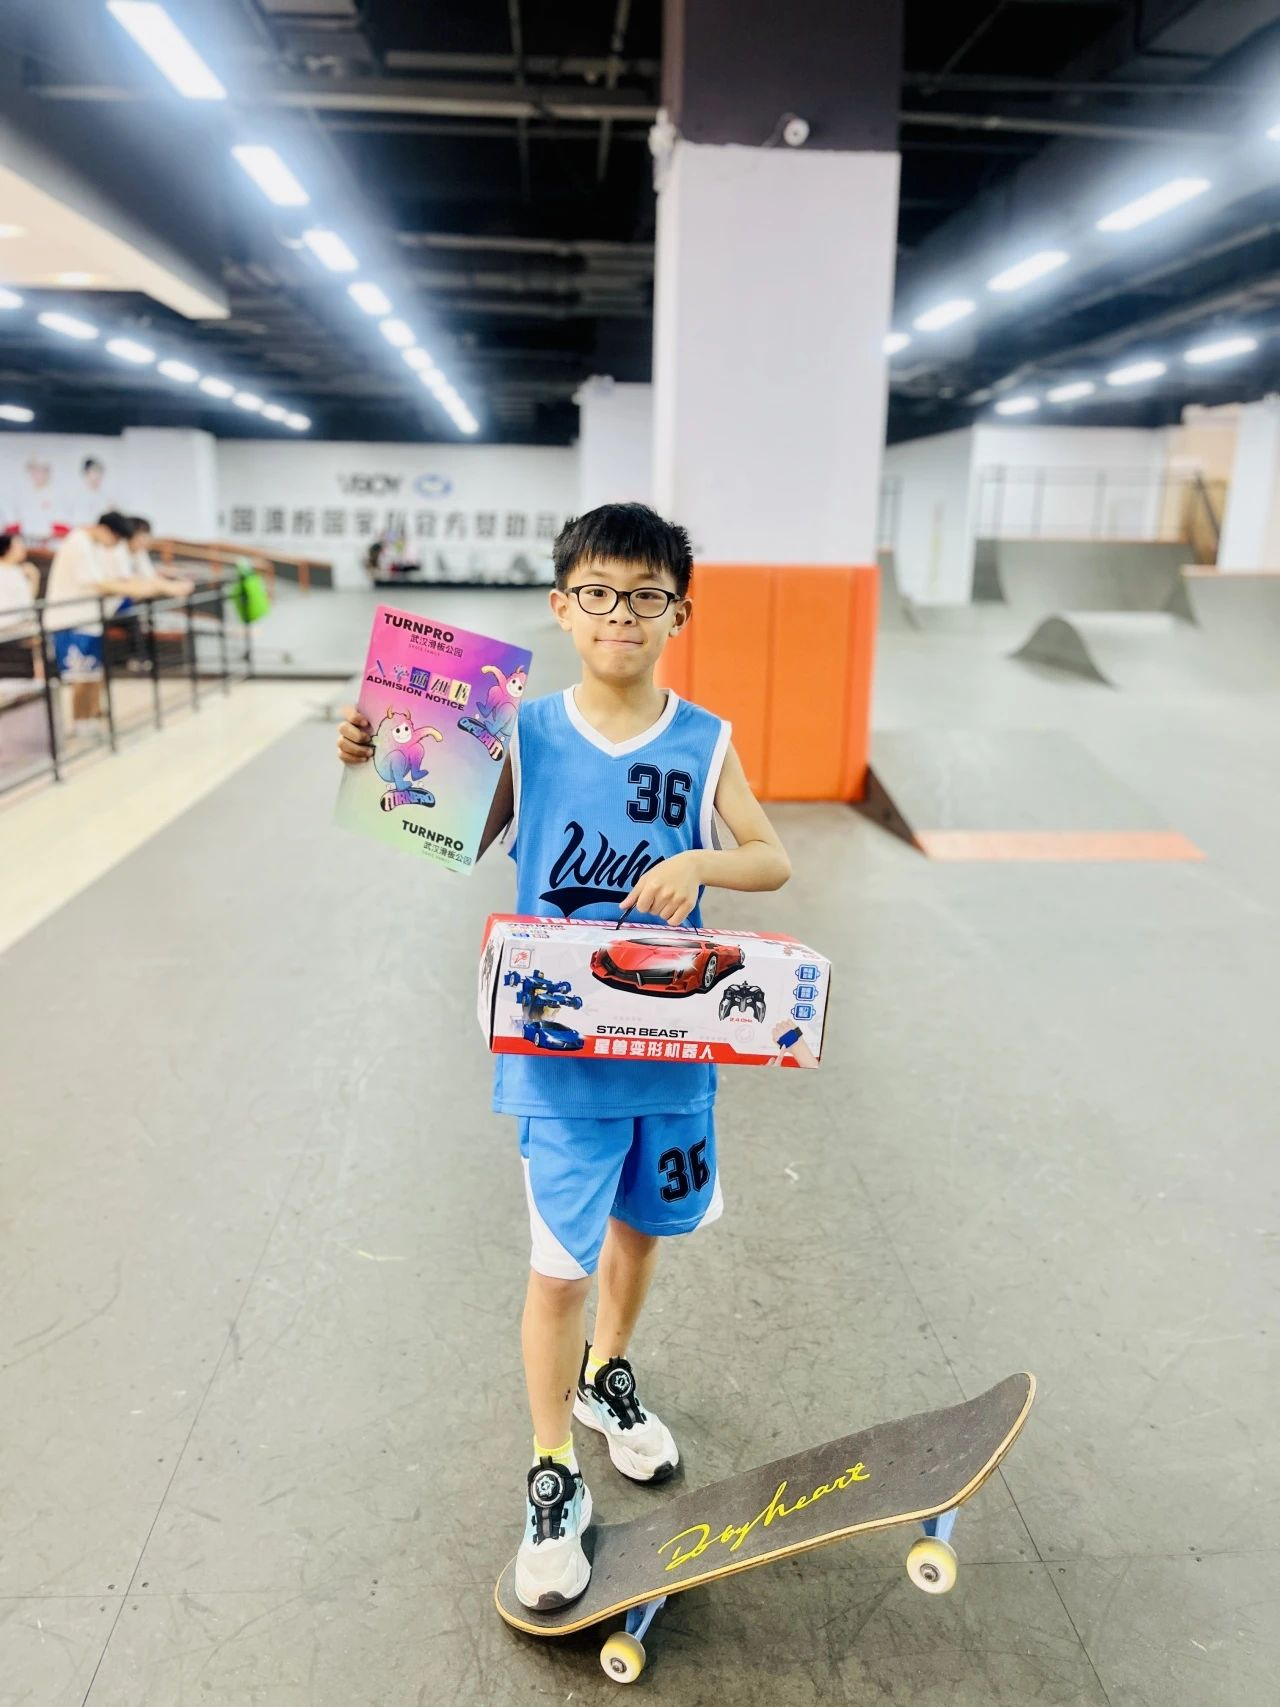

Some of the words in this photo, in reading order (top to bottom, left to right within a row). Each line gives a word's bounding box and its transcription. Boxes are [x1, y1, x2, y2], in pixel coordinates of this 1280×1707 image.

[384, 613, 454, 643] TURNPRO
[410, 634, 464, 658] 武汉滑板公园
[366, 675, 422, 697] ADMISION
[425, 692, 465, 711] NOTICE
[626, 762, 693, 829] 36
[402, 819, 464, 851] TURNPRO
[423, 841, 472, 866] 武汉滑板公园
[596, 1025, 636, 1036] STAR
[638, 1027, 688, 1039] BEAST
[594, 1038, 714, 1060] 星兽变形机器人
[657, 1136, 710, 1203] 36
